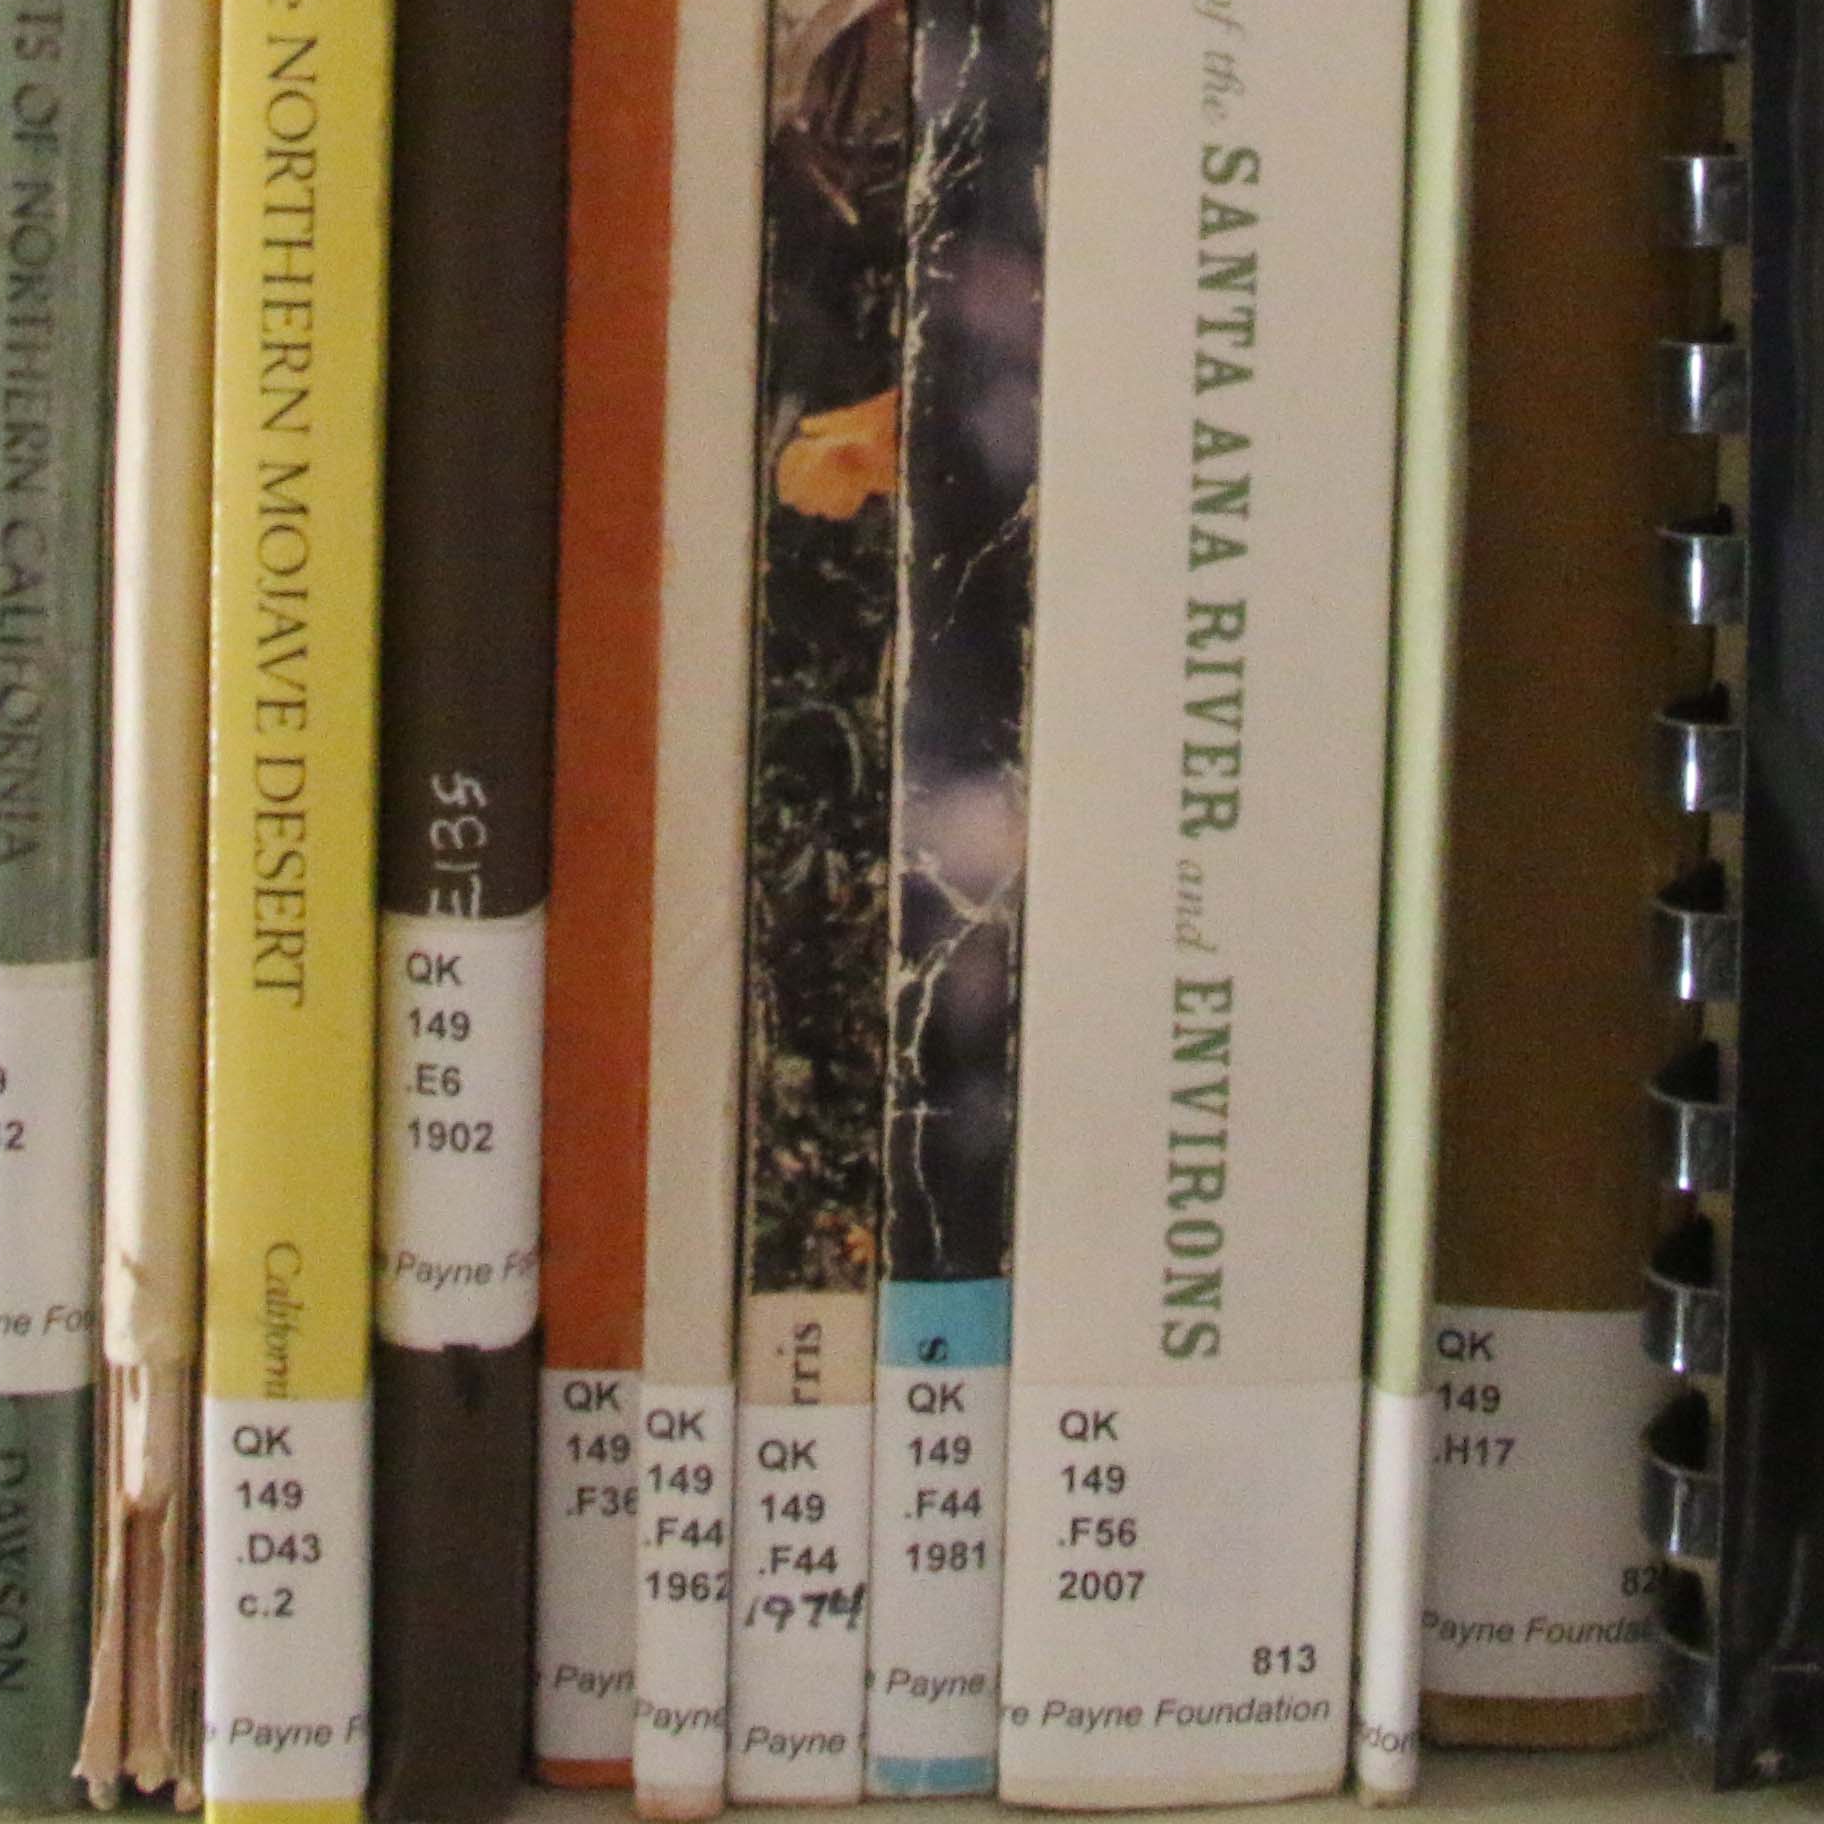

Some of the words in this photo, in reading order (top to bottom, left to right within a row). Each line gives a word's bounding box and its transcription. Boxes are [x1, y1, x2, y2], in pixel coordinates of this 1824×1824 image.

[11, 83, 59, 152] OF
[258, 34, 318, 433] NORTHERN
[1193, 141, 1260, 396] SANTA
[1, 178, 56, 493] NORTHERN
[1187, 418, 1252, 572] ANA
[253, 459, 311, 734] MOJAVE
[1178, 599, 1248, 839] RIVER
[251, 754, 307, 1008] DESERT
[1176, 858, 1218, 954] and
[407, 952, 463, 987] QK
[406, 1010, 472, 1043] 149
[406, 1064, 462, 1097] .E6
[407, 1121, 495, 1155] 1902
[1158, 976, 1234, 1361] ENVIRONS
[395, 1251, 494, 1291] Payne
[1436, 1329, 1496, 1362] QK
[564, 1381, 621, 1413] QK
[908, 1382, 966, 1414] QK
[1436, 1383, 1502, 1415] 149
[647, 1409, 706, 1441] QK
[1059, 1409, 1119, 1443] QK
[232, 1424, 294, 1460] QK
[566, 1435, 631, 1463] 149
[759, 1440, 818, 1471] QK
[907, 1436, 971, 1466] 149
[1433, 1435, 1516, 1467] .H17
[237, 1480, 304, 1511] 149
[647, 1465, 713, 1494] 149
[1060, 1466, 1126, 1495] 149
[761, 1494, 826, 1524] 149
[905, 1490, 982, 1519] .F44
[237, 1533, 323, 1565] .D43
[644, 1518, 725, 1548] .F44
[1058, 1518, 1138, 1548] .F56
[759, 1546, 839, 1576] .F44
[905, 1542, 987, 1572] 1981
[1058, 1571, 1145, 1602] 2007
[238, 1588, 294, 1619] c.2
[1421, 1613, 1514, 1648] Payne
[1252, 1644, 1318, 1676] 813
[886, 1668, 985, 1702] Payne
[1040, 1699, 1142, 1736] Payne
[1154, 1698, 1331, 1727] Foundation
[229, 1717, 332, 1754] Payne
[744, 1726, 847, 1760] Payne
